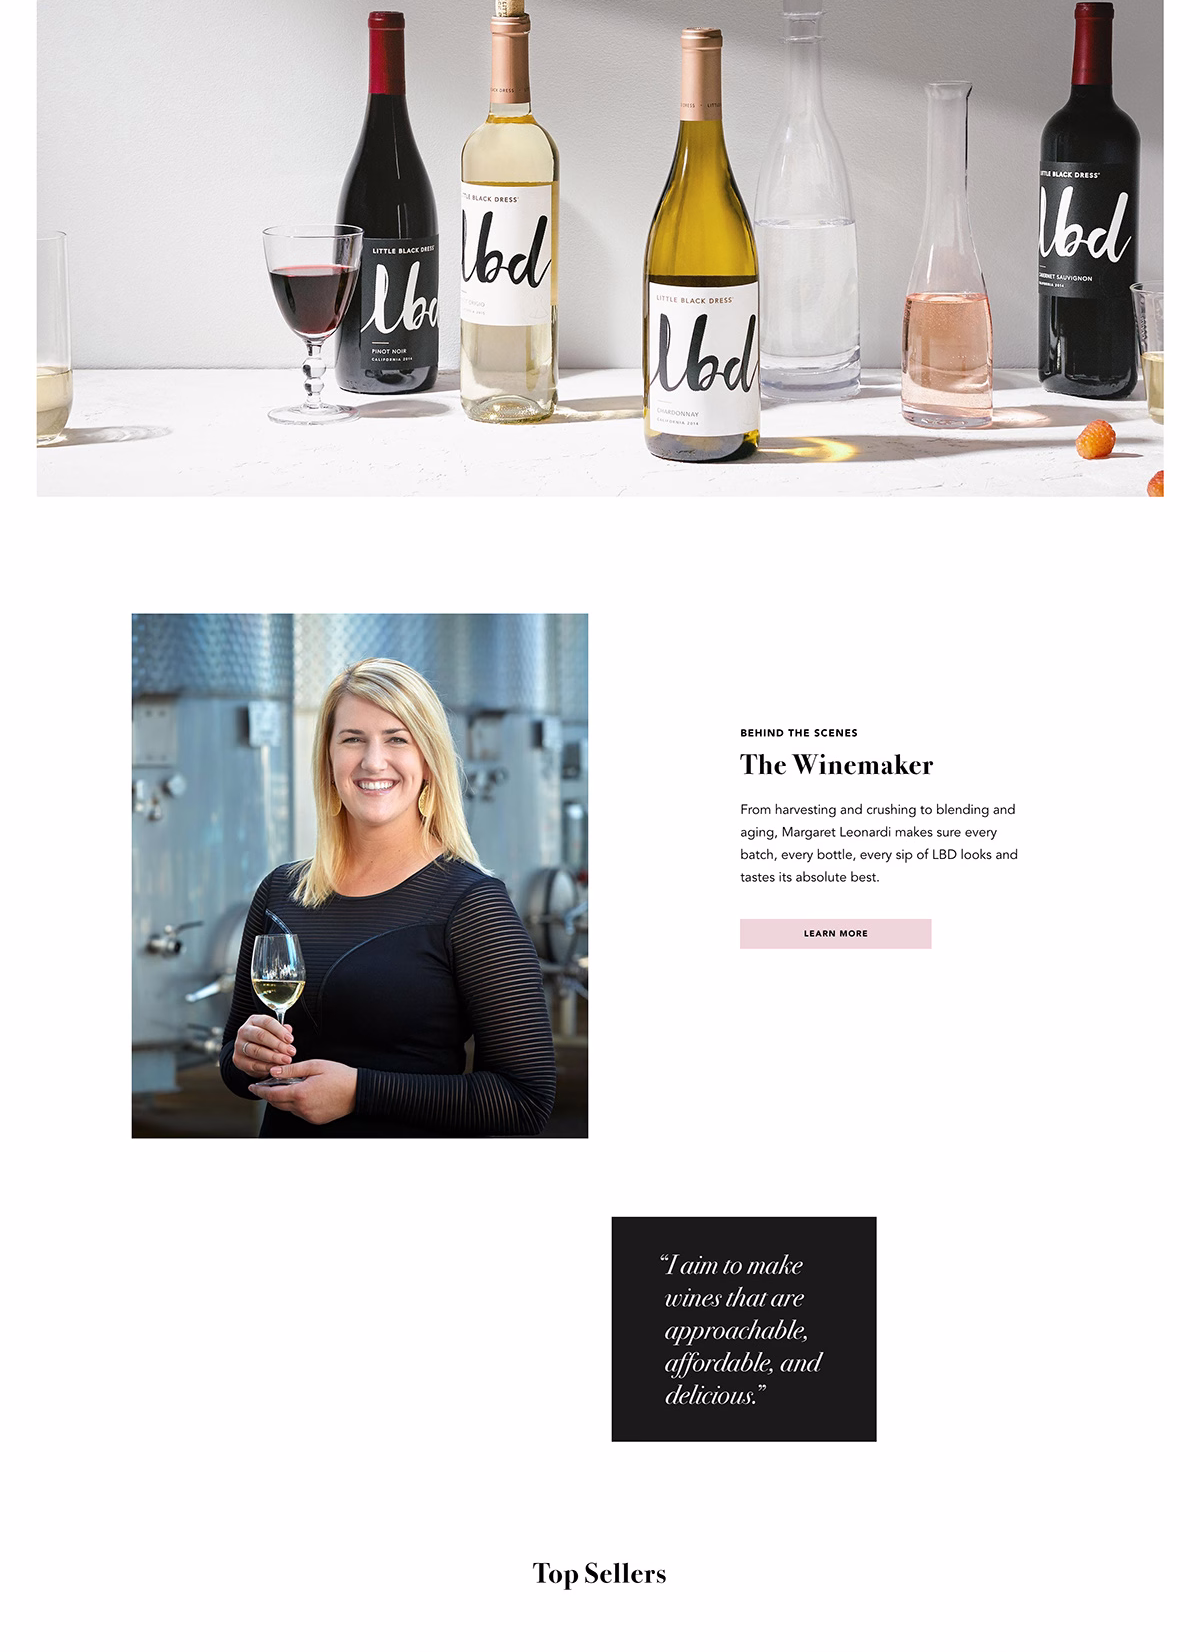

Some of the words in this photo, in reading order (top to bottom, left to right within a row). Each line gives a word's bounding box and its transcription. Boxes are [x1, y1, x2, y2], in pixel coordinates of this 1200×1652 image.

[656, 294, 678, 304] LITTLE
[708, 296, 733, 304] DRESS
[740, 728, 785, 738] BEHIND
[787, 728, 810, 738] THE
[813, 728, 858, 738] SCENES
[739, 753, 787, 776] The
[791, 753, 934, 776] Winemaker
[740, 803, 772, 815] From
[774, 803, 837, 819] harvesting
[839, 803, 863, 815] and
[866, 803, 917, 819] crushing
[919, 805, 933, 815] to
[936, 803, 990, 819] blending
[992, 803, 1016, 815] and
[740, 826, 778, 841] aging,
[782, 826, 837, 841] Margaret
[839, 825, 891, 838] Leonardi
[895, 825, 934, 838] makes
[936, 829, 962, 838] sure
[964, 829, 998, 841] every
[740, 848, 778, 862] batch,
[780, 851, 814, 864] every
[817, 848, 856, 862] bottle,
[859, 851, 893, 864] every
[895, 848, 914, 864] sip
[916, 847, 930, 860] of
[932, 848, 958, 860] LBD
[960, 848, 993, 860] looks
[995, 848, 1018, 860] and
[739, 872, 776, 883] tastes
[778, 871, 793, 883] its
[795, 870, 847, 883] absolute
[850, 870, 880, 883] best.
[803, 929, 836, 938] LEARN
[839, 929, 868, 938] MORE
[679, 1255, 718, 1275] aim
[722, 1259, 743, 1275] to
[746, 1253, 804, 1275] make
[664, 1287, 723, 1308] wines
[725, 1286, 769, 1308] that
[770, 1293, 805, 1308] are
[664, 1318, 808, 1347] approachable,
[664, 1351, 774, 1380] affordable,
[779, 1351, 825, 1373] and
[532, 1562, 579, 1591] Top
[584, 1561, 667, 1584] Sellers
